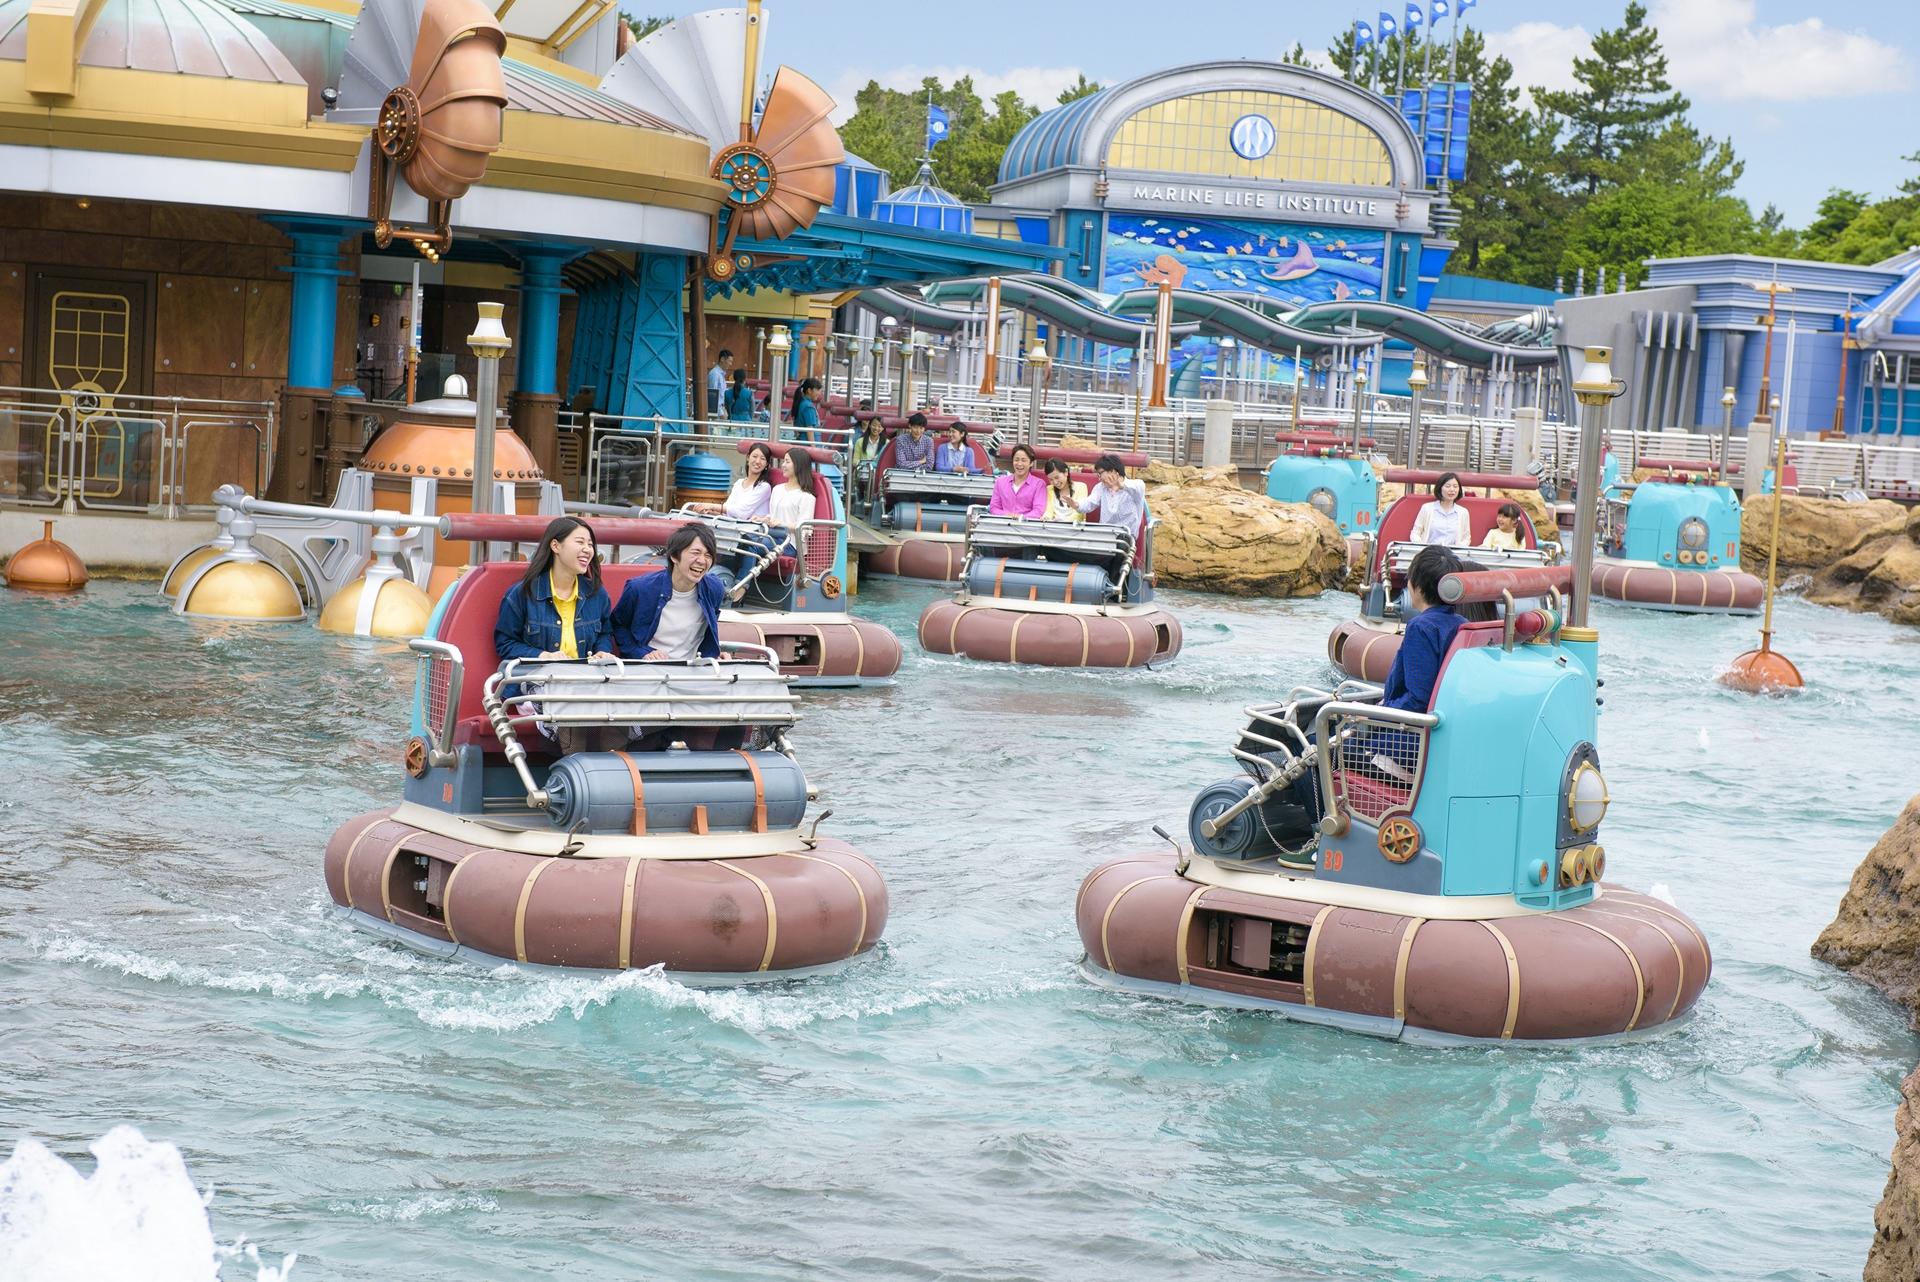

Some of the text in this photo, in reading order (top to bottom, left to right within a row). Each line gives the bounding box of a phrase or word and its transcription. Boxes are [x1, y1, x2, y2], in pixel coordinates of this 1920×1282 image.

[1134, 185, 1377, 216] MARINE LIFE INSTITUTE
[1356, 510, 1370, 526] 60
